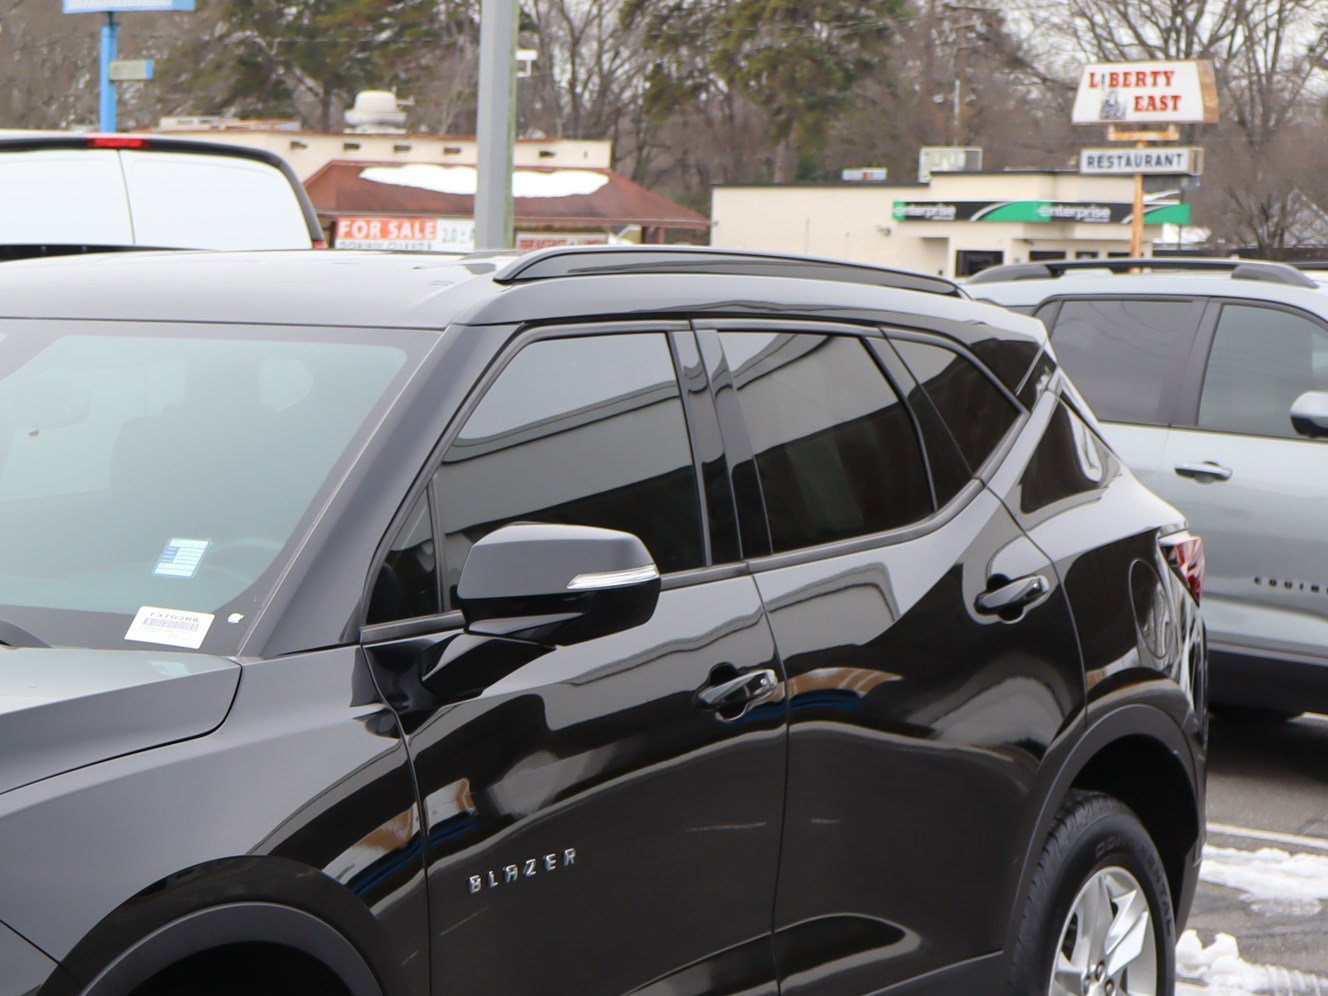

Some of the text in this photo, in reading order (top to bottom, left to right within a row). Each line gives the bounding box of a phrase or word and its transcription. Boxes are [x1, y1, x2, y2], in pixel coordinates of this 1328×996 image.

[1088, 70, 1176, 89] LIBERTY
[1134, 95, 1183, 113] EAST
[1086, 153, 1184, 169] RESTAURANT
[339, 220, 437, 240] FOR SALE
[468, 847, 577, 894] BLAZER
